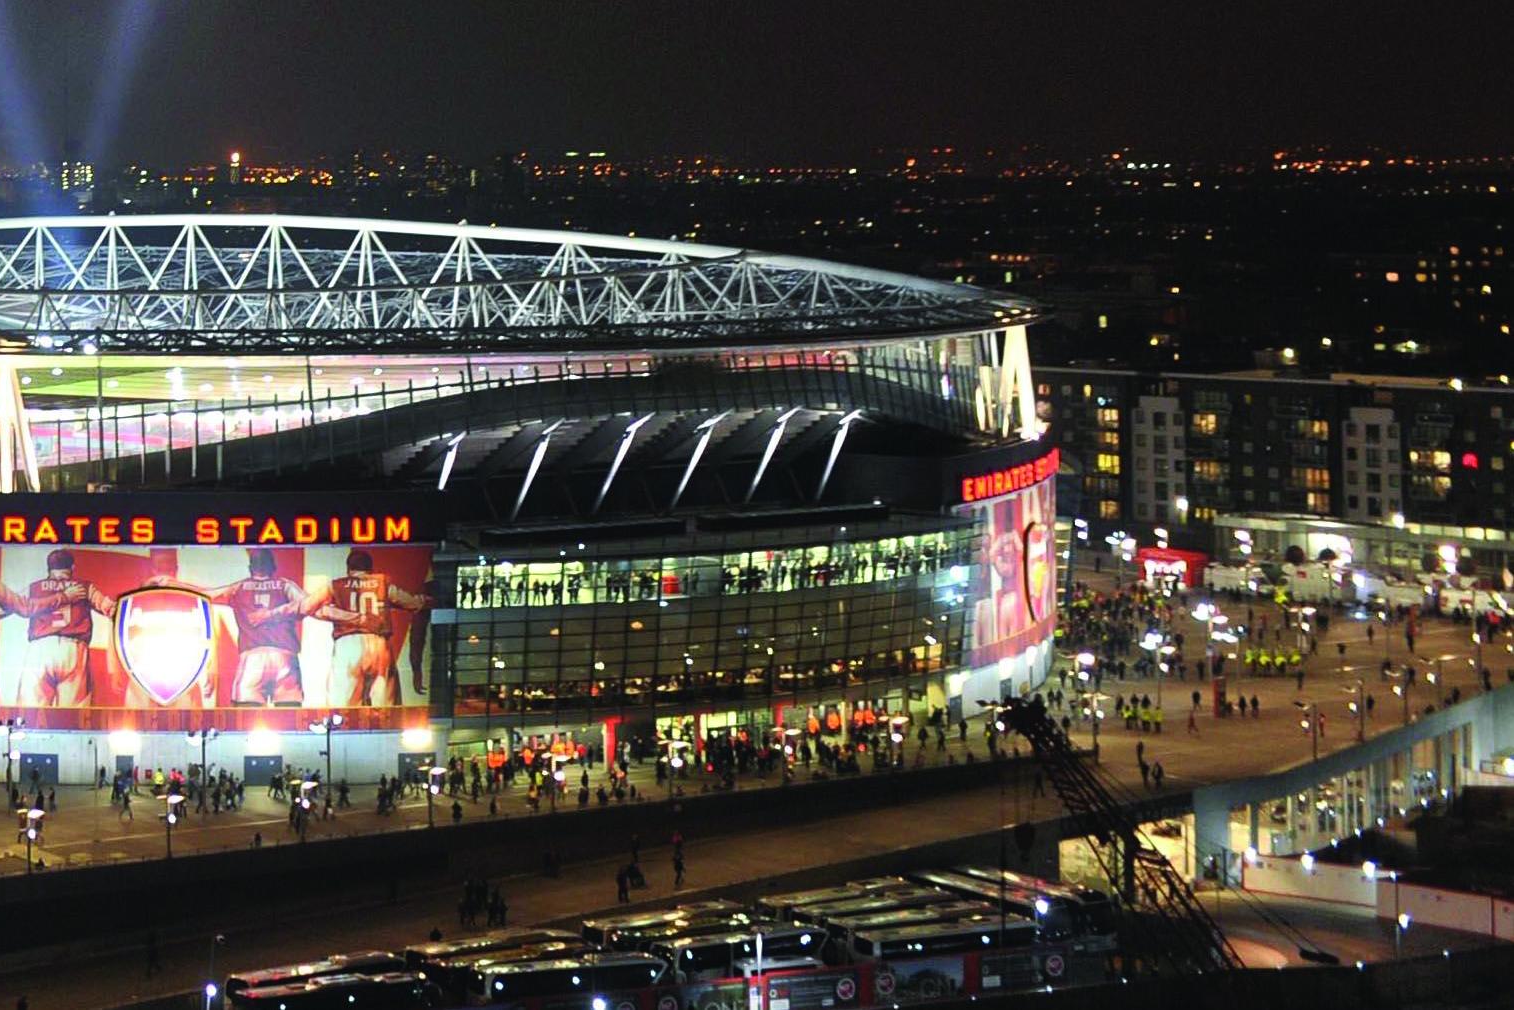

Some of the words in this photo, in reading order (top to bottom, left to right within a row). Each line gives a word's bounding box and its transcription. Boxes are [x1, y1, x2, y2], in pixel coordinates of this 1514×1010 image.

[962, 462, 1034, 503] EMIRATES
[195, 516, 410, 543] STADIUM
[344, 579, 379, 589] JAMES
